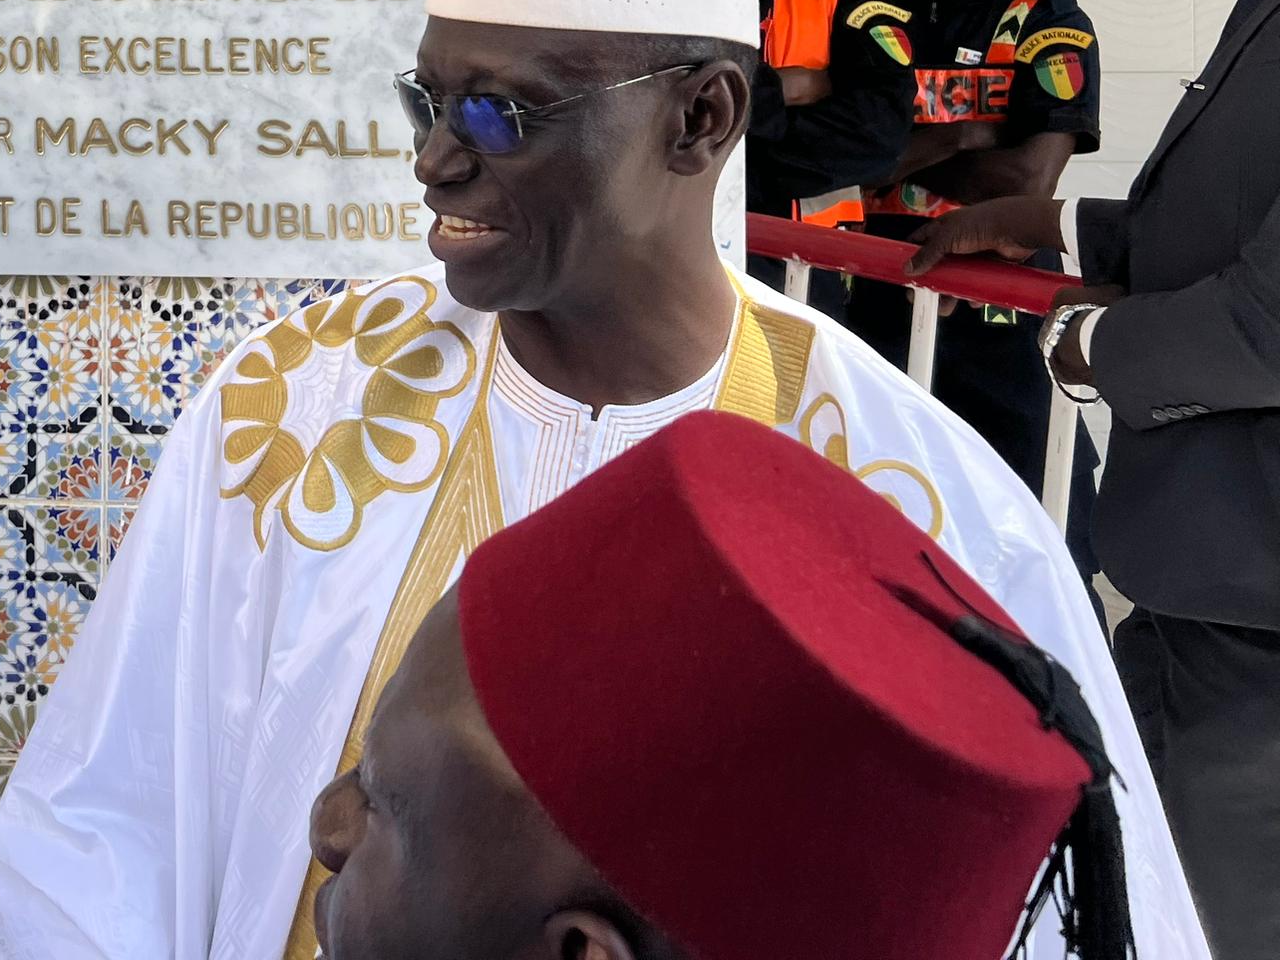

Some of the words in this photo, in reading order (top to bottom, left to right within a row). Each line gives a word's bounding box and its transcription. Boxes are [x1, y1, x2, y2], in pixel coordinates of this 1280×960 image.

[79, 36, 332, 76] EXCELLENCE
[1041, 31, 1088, 44] NATIONALE
[35, 117, 229, 157] MACKY
[257, 119, 413, 162] SALL,
[36, 197, 82, 237] DE
[102, 198, 150, 238] LA
[167, 200, 421, 240] REPUBLIQUE
